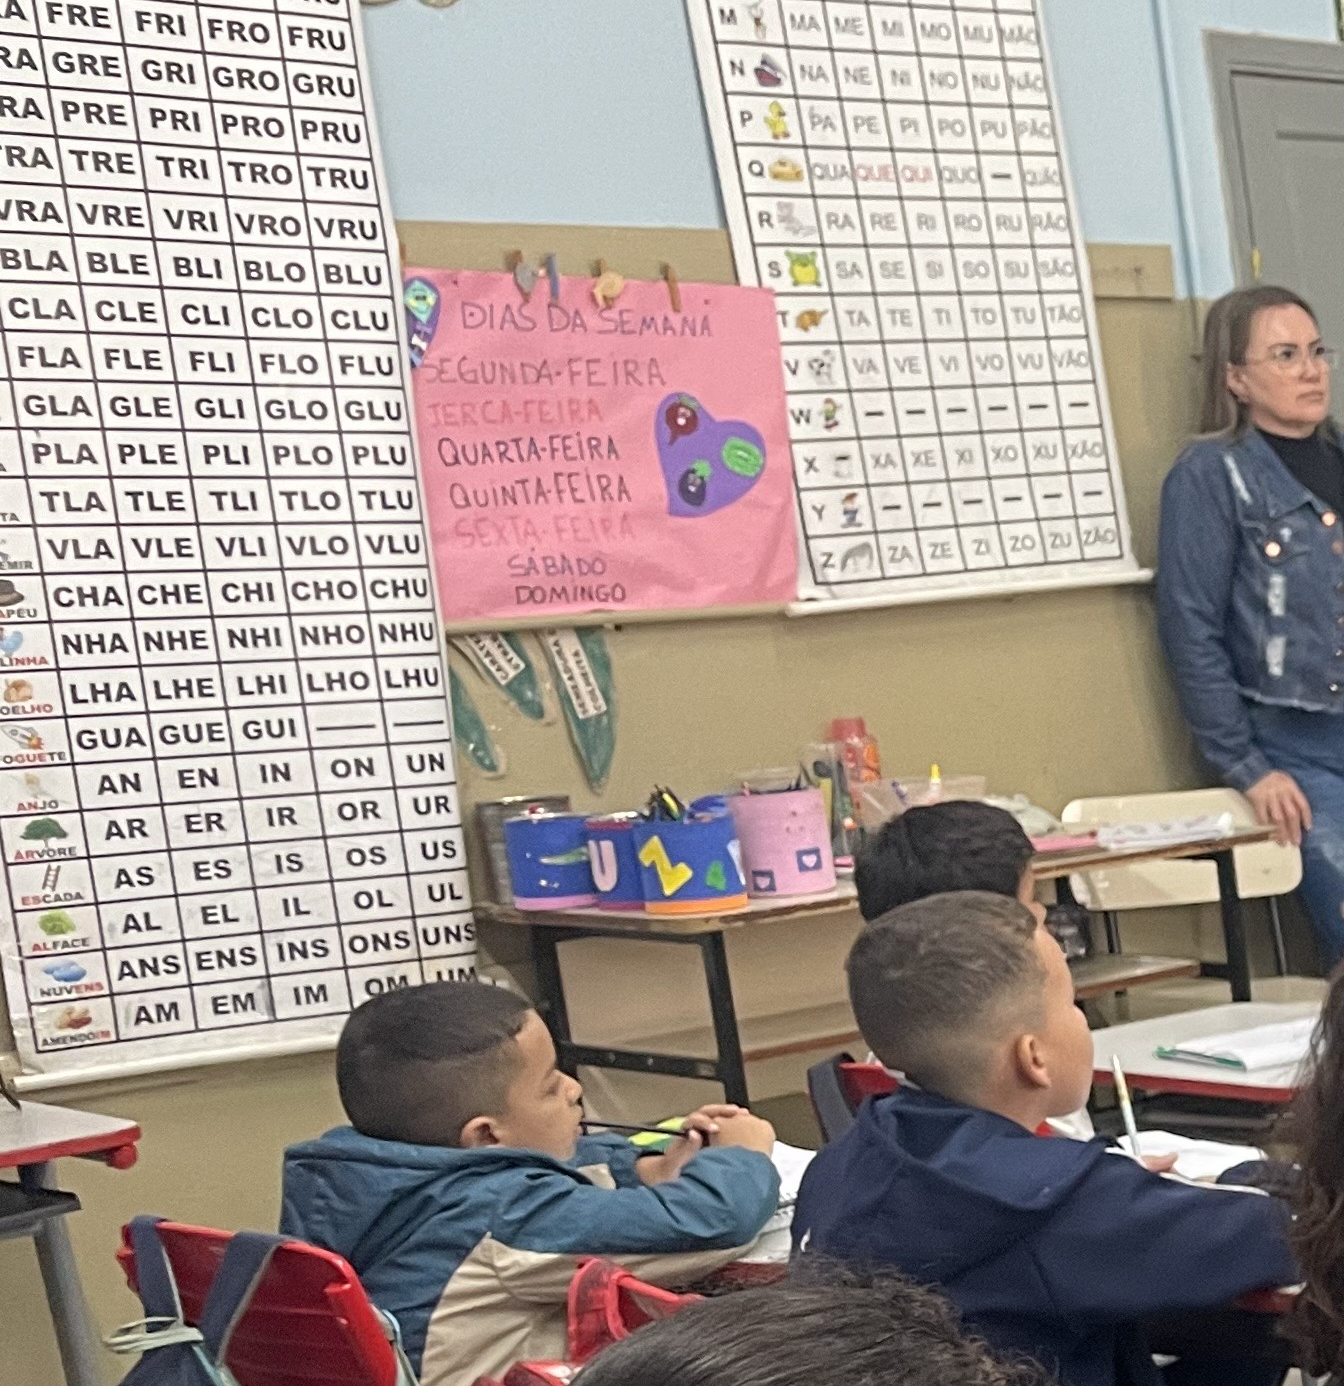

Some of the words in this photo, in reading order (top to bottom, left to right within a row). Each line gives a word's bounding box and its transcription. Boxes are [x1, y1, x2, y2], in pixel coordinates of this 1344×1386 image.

[45, 1, 112, 29] FRE
[135, 10, 187, 37] FRI
[207, 18, 270, 44] FRO
[287, 26, 346, 52] FRU
[60, 100, 128, 126] PRE
[149, 107, 201, 133] PRI
[220, 113, 285, 138] PRO
[300, 119, 361, 144] PRU
[76, 203, 145, 228] VRE
[163, 208, 218, 233] VRI
[234, 213, 301, 237] VRO
[313, 217, 378, 241] VRU
[0, 248, 68, 272] BLA
[86, 251, 150, 276] BLE
[172, 256, 223, 280] BLI
[243, 260, 306, 283] BLO
[323, 264, 382, 286] BLU
[8, 297, 77, 321] CLA
[95, 300, 158, 324] CLE
[181, 303, 230, 326] CLI
[251, 307, 313, 329] CLO
[330, 309, 389, 331] CLU
[461, 300, 536, 331] DIAS
[548, 302, 587, 334] DA
[23, 394, 93, 417] GLA
[109, 396, 173, 418] GLE
[194, 398, 245, 419] GLI
[264, 399, 328, 420] GLO
[344, 400, 402, 421] GLU
[437, 431, 621, 467] QUARTA-FEIRA
[39, 491, 107, 513] TLA
[124, 490, 186, 512] TLE
[208, 490, 258, 512] TLI
[279, 490, 341, 511] TLO
[358, 490, 413, 510] TLU
[449, 468, 633, 510] QUINTA-FEIRA
[53, 585, 125, 608] CHA
[137, 583, 204, 606] CHE
[221, 582, 275, 603] CHI
[291, 580, 358, 601] CHO
[370, 578, 428, 599] CHU
[515, 582, 626, 605] DOMINGO
[61, 632, 130, 655] NHA
[143, 629, 209, 652] NHE
[227, 627, 282, 649] NHI
[299, 624, 365, 646] NHO
[378, 622, 434, 643] NHU
[76, 727, 147, 751] GUA
[158, 722, 226, 745] GUE
[242, 718, 297, 740] GUI
[16, 800, 59, 812] ANJO
[97, 772, 142, 796] AN
[177, 767, 220, 790] EN
[259, 762, 291, 784] IN
[330, 757, 375, 779] ON
[406, 752, 445, 774] UN
[104, 818, 149, 841] AR
[184, 812, 226, 834] ER
[266, 806, 298, 827] IR
[337, 800, 382, 822] OR
[412, 795, 451, 816] UR
[32, 937, 90, 952] ALFACE
[122, 911, 163, 934] AL
[200, 904, 240, 926] EL
[282, 897, 311, 917] IL
[353, 889, 395, 910] OL
[427, 882, 463, 903] UL
